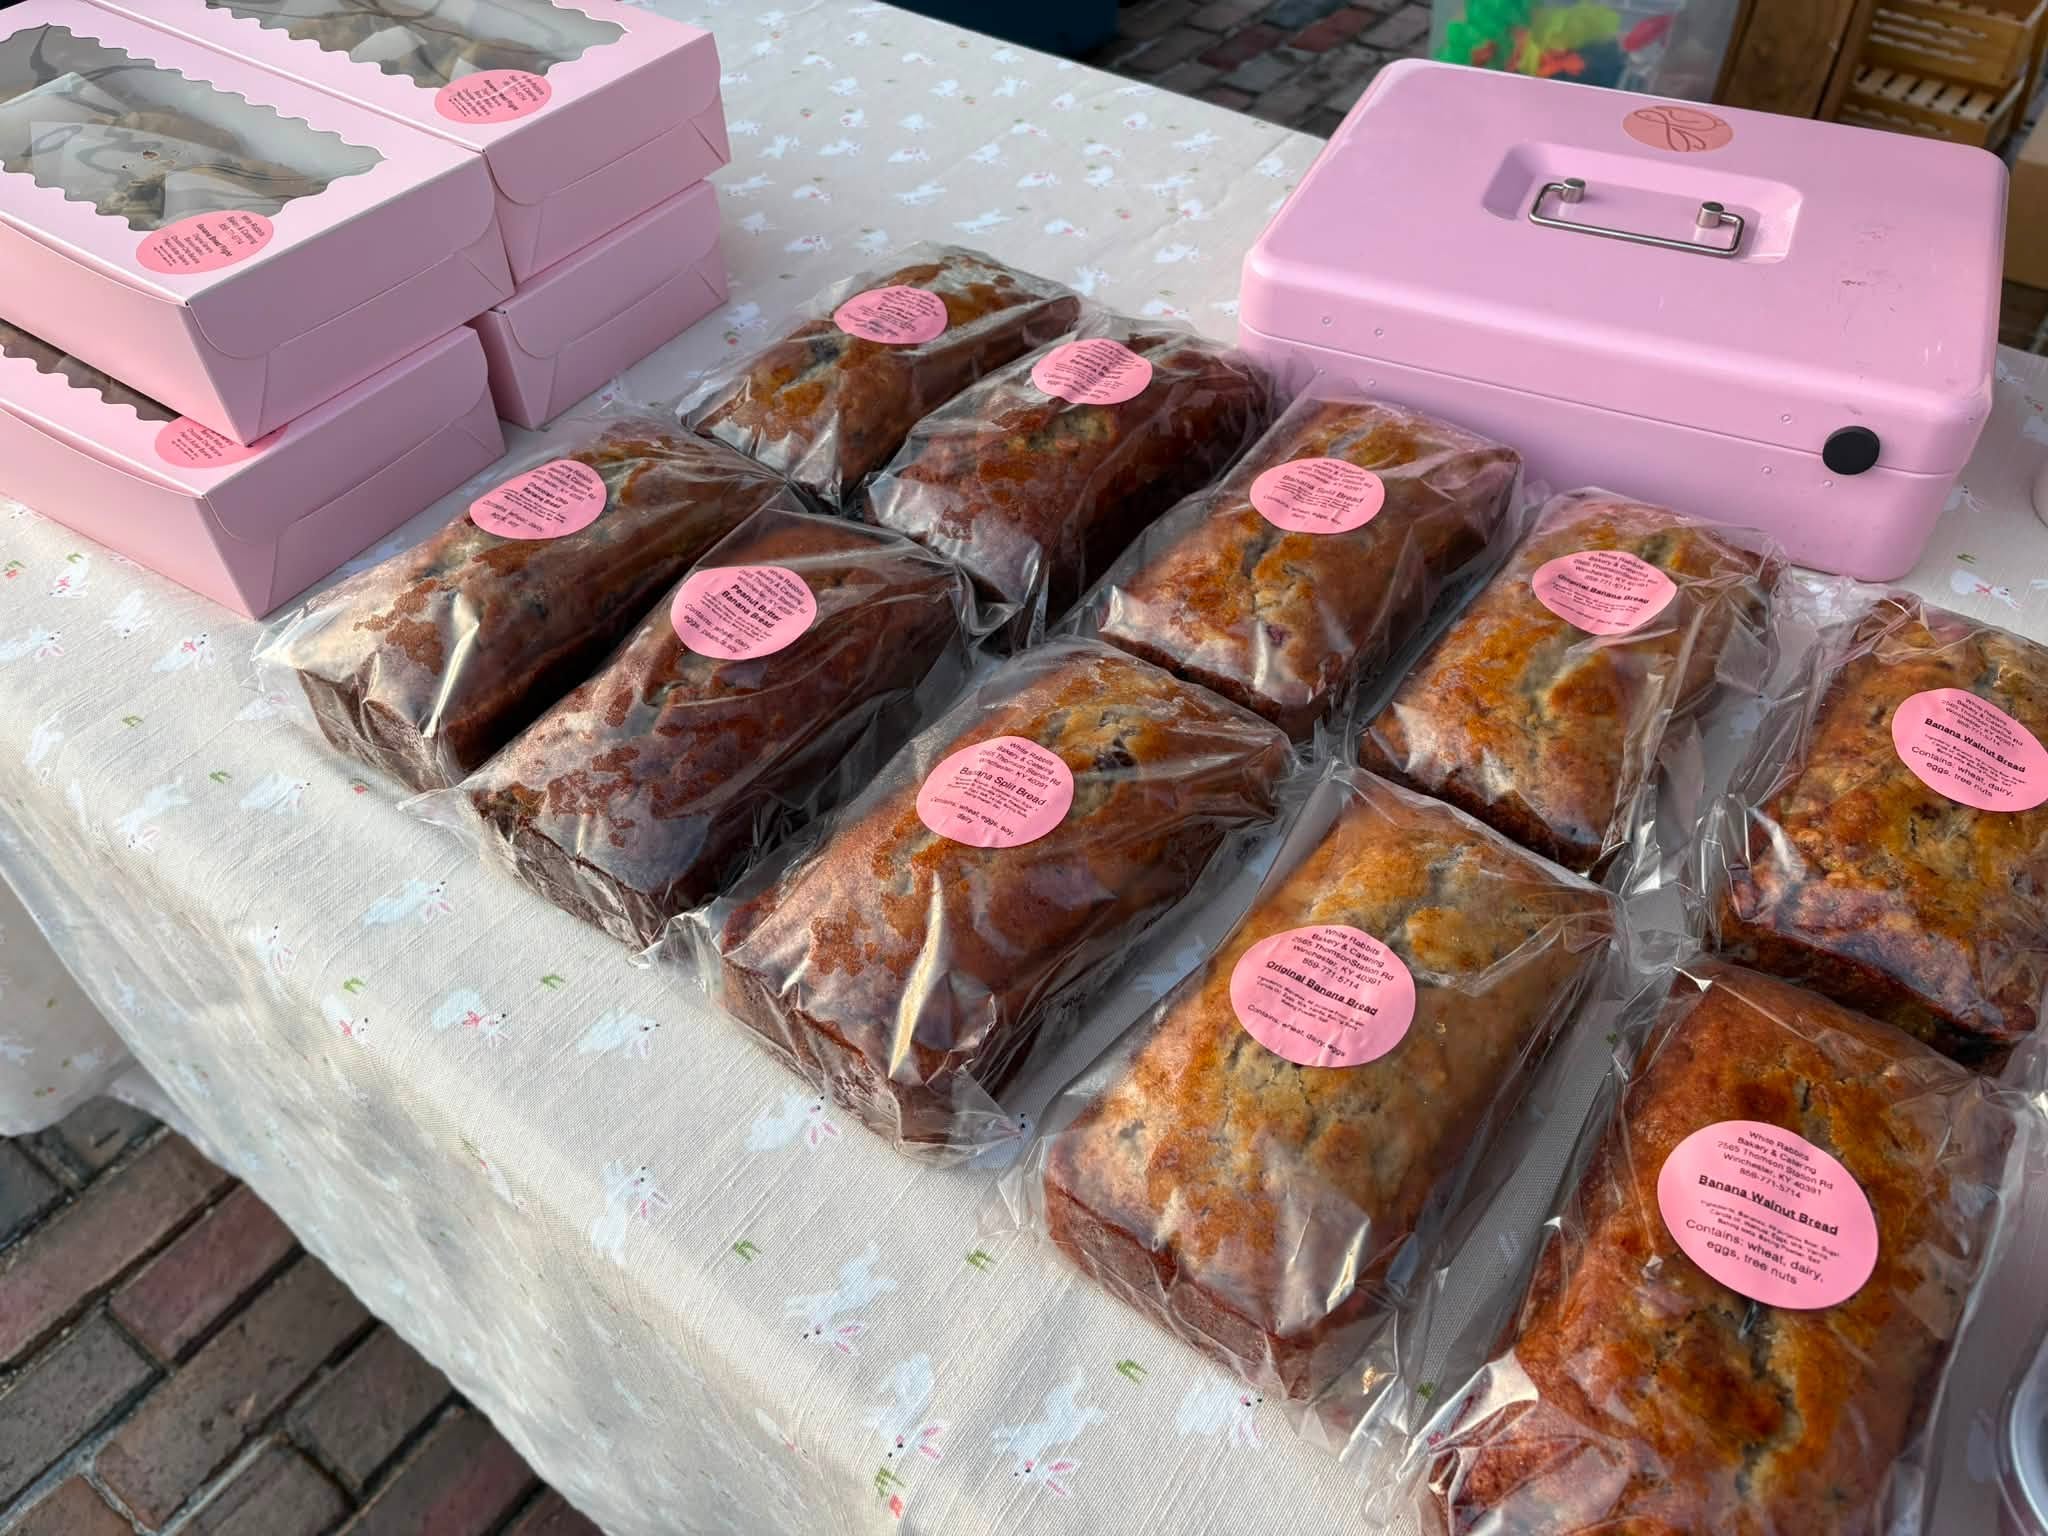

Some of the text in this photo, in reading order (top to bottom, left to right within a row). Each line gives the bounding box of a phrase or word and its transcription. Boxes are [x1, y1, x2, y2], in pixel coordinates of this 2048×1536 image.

[721, 591, 750, 614] Banana
[751, 612, 775, 628] Bread
[731, 584, 759, 606] Peanut
[758, 605, 782, 621] Butter
[1590, 587, 1622, 600] Banana
[1010, 742, 1028, 755] White
[1925, 718, 1960, 739] Banana
[1963, 735, 1995, 760] Walnut
[1997, 755, 2026, 773] Bread
[994, 776, 1018, 791] Split
[1016, 787, 1046, 806] Bread
[1051, 778, 1061, 786] Rd
[1926, 762, 1993, 797] eggs, tree nuts
[1958, 766, 1986, 785] wheat,
[1988, 781, 2014, 797] dairy,
[1312, 933, 1339, 947] Bakery
[1350, 949, 1385, 968] Catering
[1325, 928, 1380, 955] White Rabbits
[1341, 966, 1355, 974] KY
[1357, 972, 1382, 986] 40391
[1351, 959, 1379, 975] Station
[1382, 971, 1394, 981] Rd
[1266, 961, 1306, 984] Original
[1307, 978, 1344, 1001] Banana
[1346, 998, 1378, 1016] Bread
[1737, 1137, 1769, 1153] Bakery
[1780, 1152, 1817, 1174] Catering
[1749, 1131, 1809, 1161] White Rabbits
[1724, 1153, 1822, 1196] Winchester, KY 40391
[1744, 1149, 1784, 1169] Thomson
[1786, 1166, 1817, 1183] Station
[1819, 1178, 1833, 1189] Rd
[1699, 1175, 1746, 1199] Banana
[1752, 1191, 1795, 1220] Walnut
[1799, 1212, 1838, 1236] Bread
[1686, 1219, 1744, 1245] Contains:
[1747, 1241, 1786, 1266] wheat,
[1790, 1259, 1824, 1282] dairy,
[1707, 1240, 1797, 1285] eggs, tree nuts
